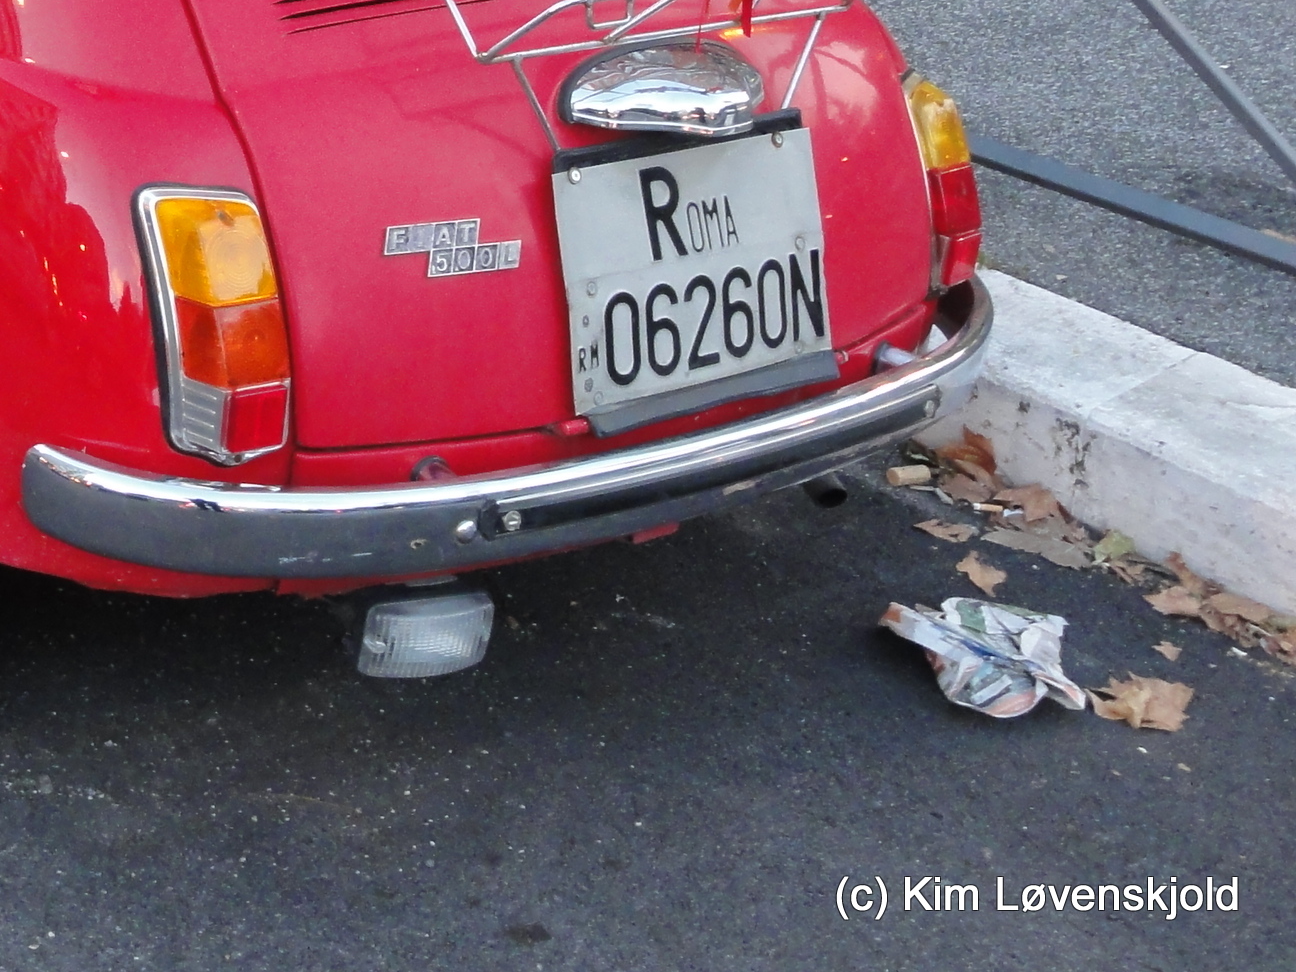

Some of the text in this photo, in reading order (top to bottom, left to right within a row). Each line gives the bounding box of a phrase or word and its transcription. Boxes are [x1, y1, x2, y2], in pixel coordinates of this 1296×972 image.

[389, 222, 476, 251] FIAT
[435, 243, 515, 271] 500L
[603, 247, 826, 386] 06260N
[577, 340, 600, 372] RM
